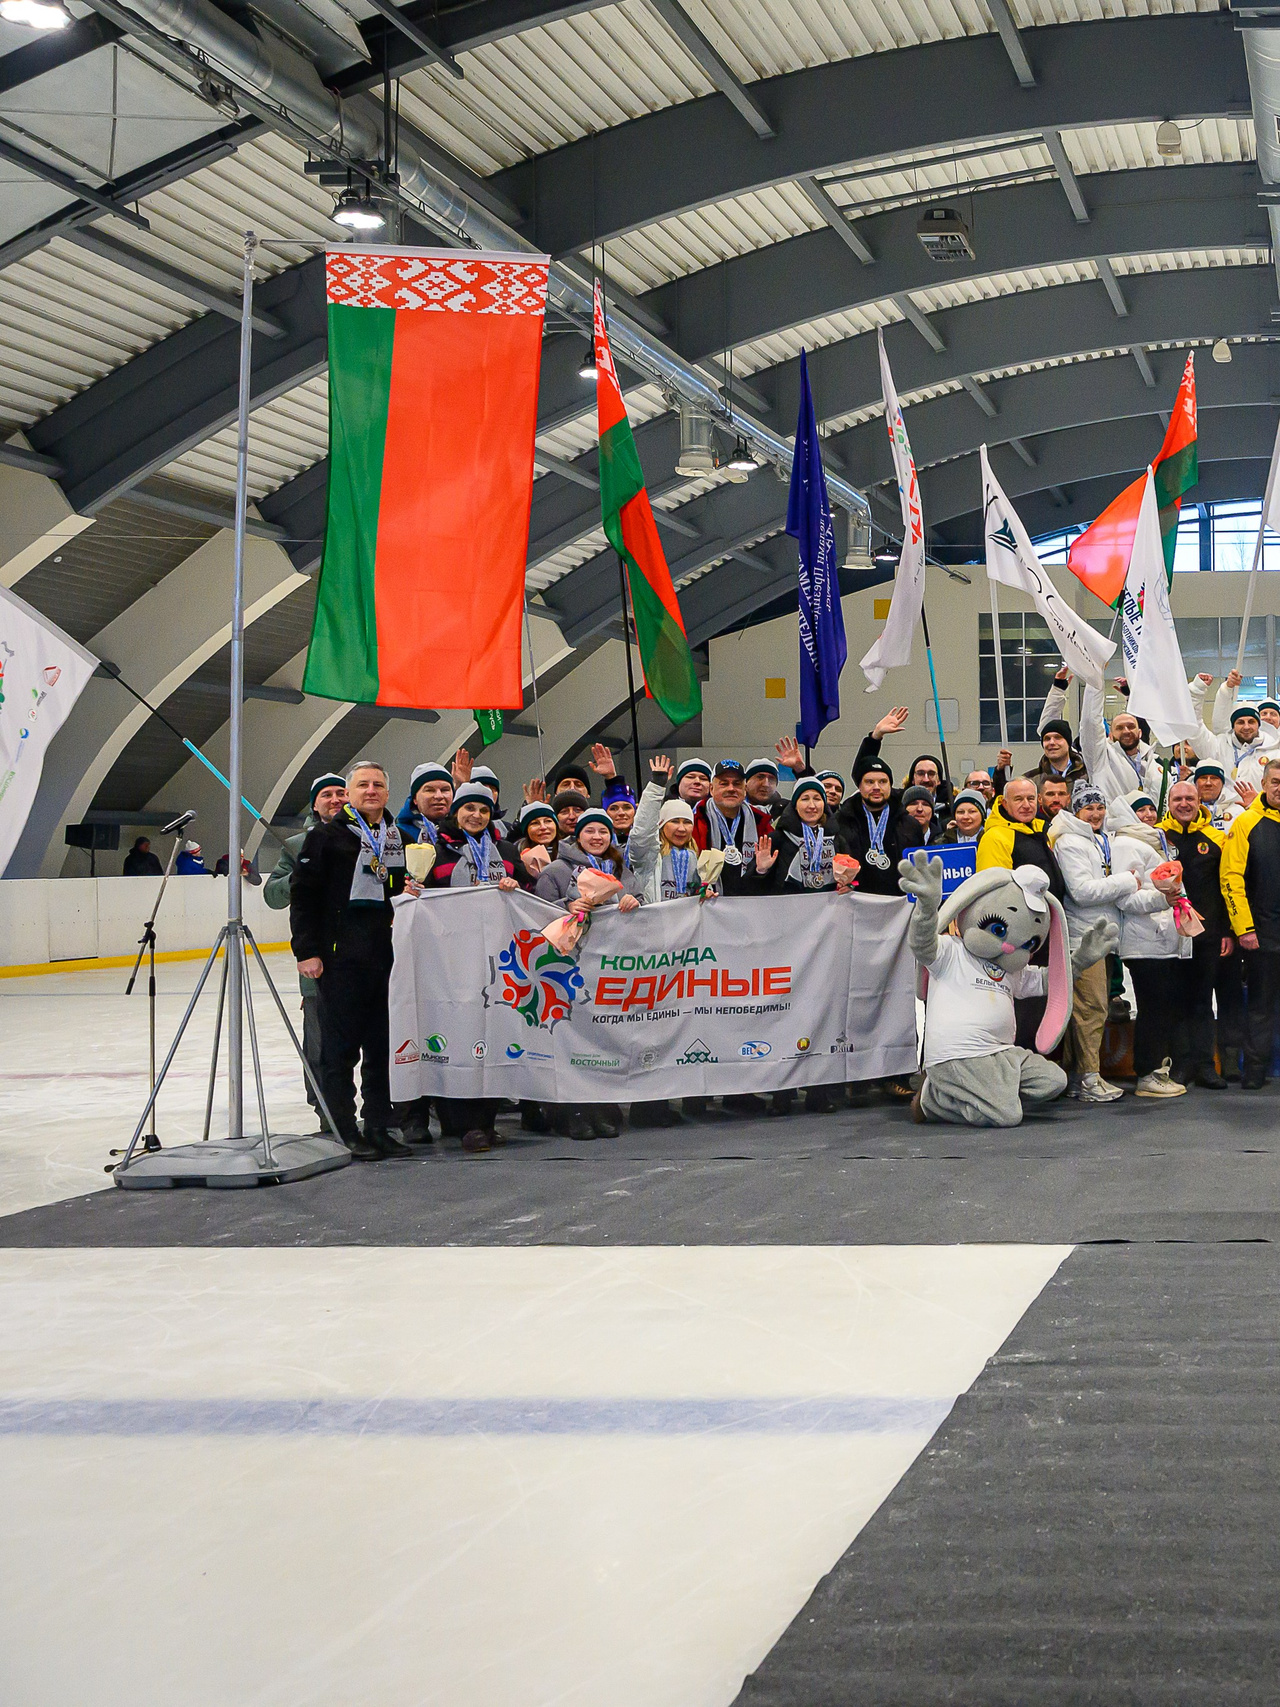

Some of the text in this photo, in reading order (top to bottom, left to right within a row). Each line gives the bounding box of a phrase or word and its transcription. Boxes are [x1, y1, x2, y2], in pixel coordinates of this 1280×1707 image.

[1124, 584, 1143, 625] ЕЛЫЕ
[1122, 622, 1139, 654] АБОТНИКОВ
[943, 866, 973, 880] ные
[600, 947, 717, 971] КОМАНДА
[594, 966, 792, 1012] ЕДИНЫЕ
[592, 1013, 624, 1025] КОГДА
[626, 1012, 644, 1023] МЫ
[647, 1008, 680, 1021] ЕДИНЫ
[694, 1006, 713, 1015] МЫ
[715, 1002, 791, 1015] НЕПОБЕДИМЫ!
[570, 1057, 620, 1068] ВОСТОЧНЫЙ
